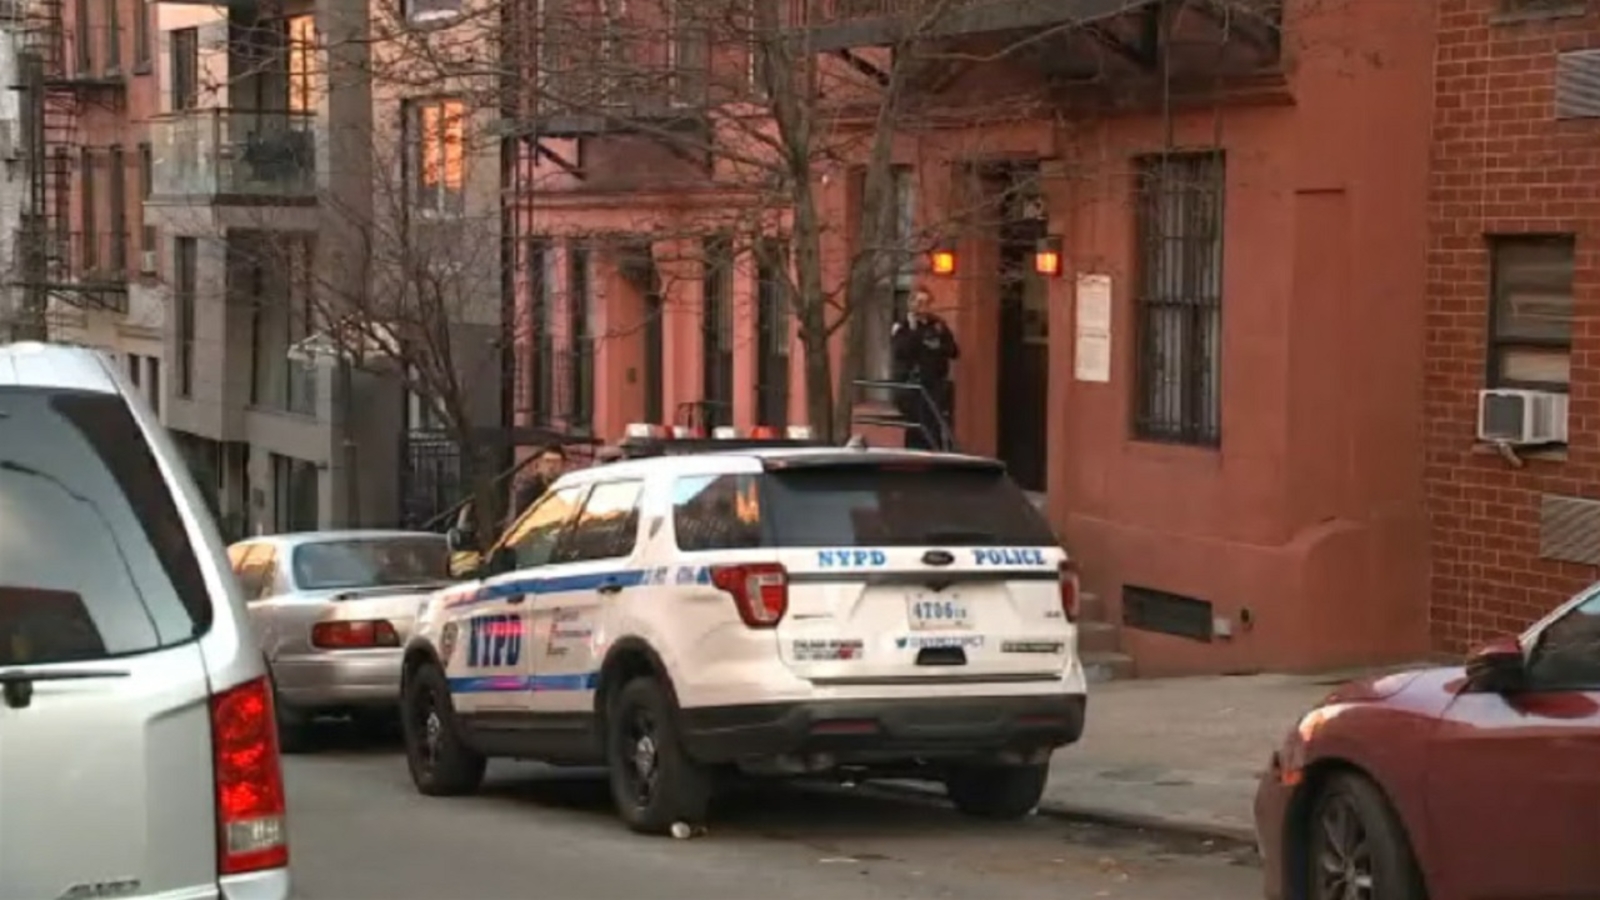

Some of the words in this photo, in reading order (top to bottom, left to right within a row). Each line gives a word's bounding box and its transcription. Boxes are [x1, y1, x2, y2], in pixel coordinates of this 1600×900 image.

[817, 549, 887, 568] NYPD
[971, 548, 1047, 566] POLICE
[467, 614, 522, 667] NYPD
